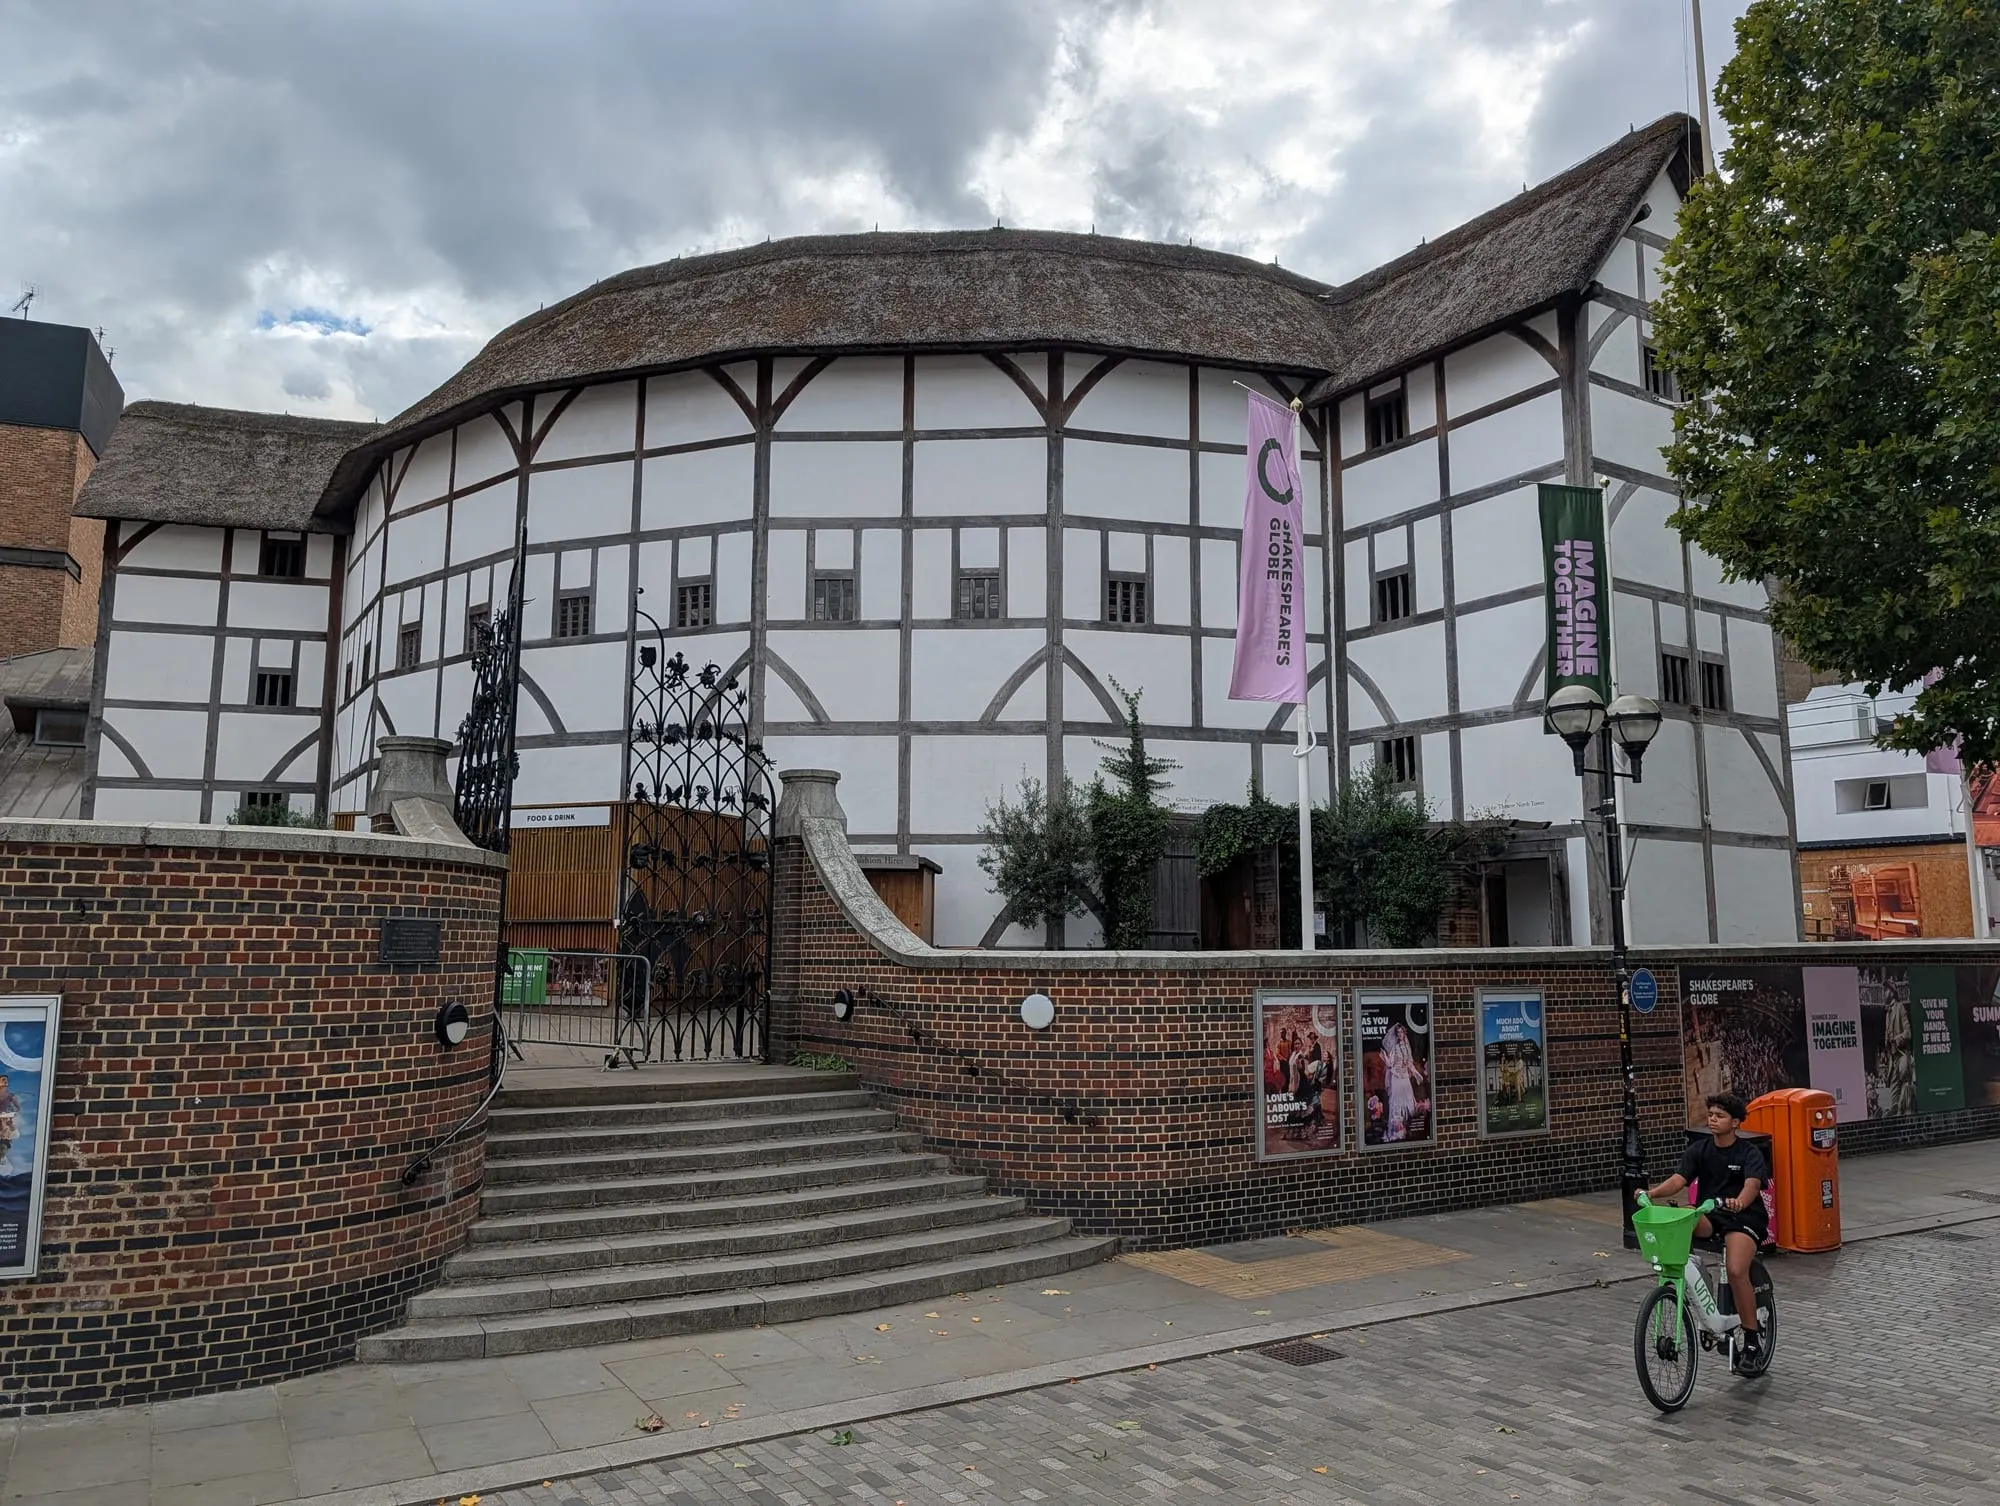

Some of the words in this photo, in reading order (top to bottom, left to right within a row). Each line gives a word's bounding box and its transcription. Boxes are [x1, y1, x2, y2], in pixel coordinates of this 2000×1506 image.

[1266, 517, 1281, 580] GLOBE
[1554, 540, 1574, 677] TOGETHER
[1573, 540, 1599, 676] IMAGINE
[1689, 979, 1754, 991] SHAKESPEARE'S
[1690, 993, 1719, 1005] GLOBE
[1939, 998, 1948, 1008] ME
[1925, 1010, 1945, 1020] YOUR
[1361, 1017, 1372, 1026] AS
[1372, 1016, 1389, 1025] YOU
[1496, 1017, 1512, 1025] MUCH
[1512, 1017, 1524, 1025] ADO
[1923, 1021, 1948, 1031] HANDS,
[1362, 1026, 1379, 1035] LIKE
[1379, 1026, 1387, 1034] IT
[1812, 1020, 1857, 1036] IMAGINE
[1499, 1032, 1524, 1040] NOTHING
[1923, 1033, 1930, 1042] IF
[1930, 1032, 1940, 1042] WE
[1940, 1031, 1951, 1041] BE
[1813, 1036, 1858, 1050] TOGETHER
[1266, 1091, 1294, 1103] LOVE'S
[1266, 1101, 1307, 1113] LABOUR'S
[1266, 1113, 1289, 1123] LOST
